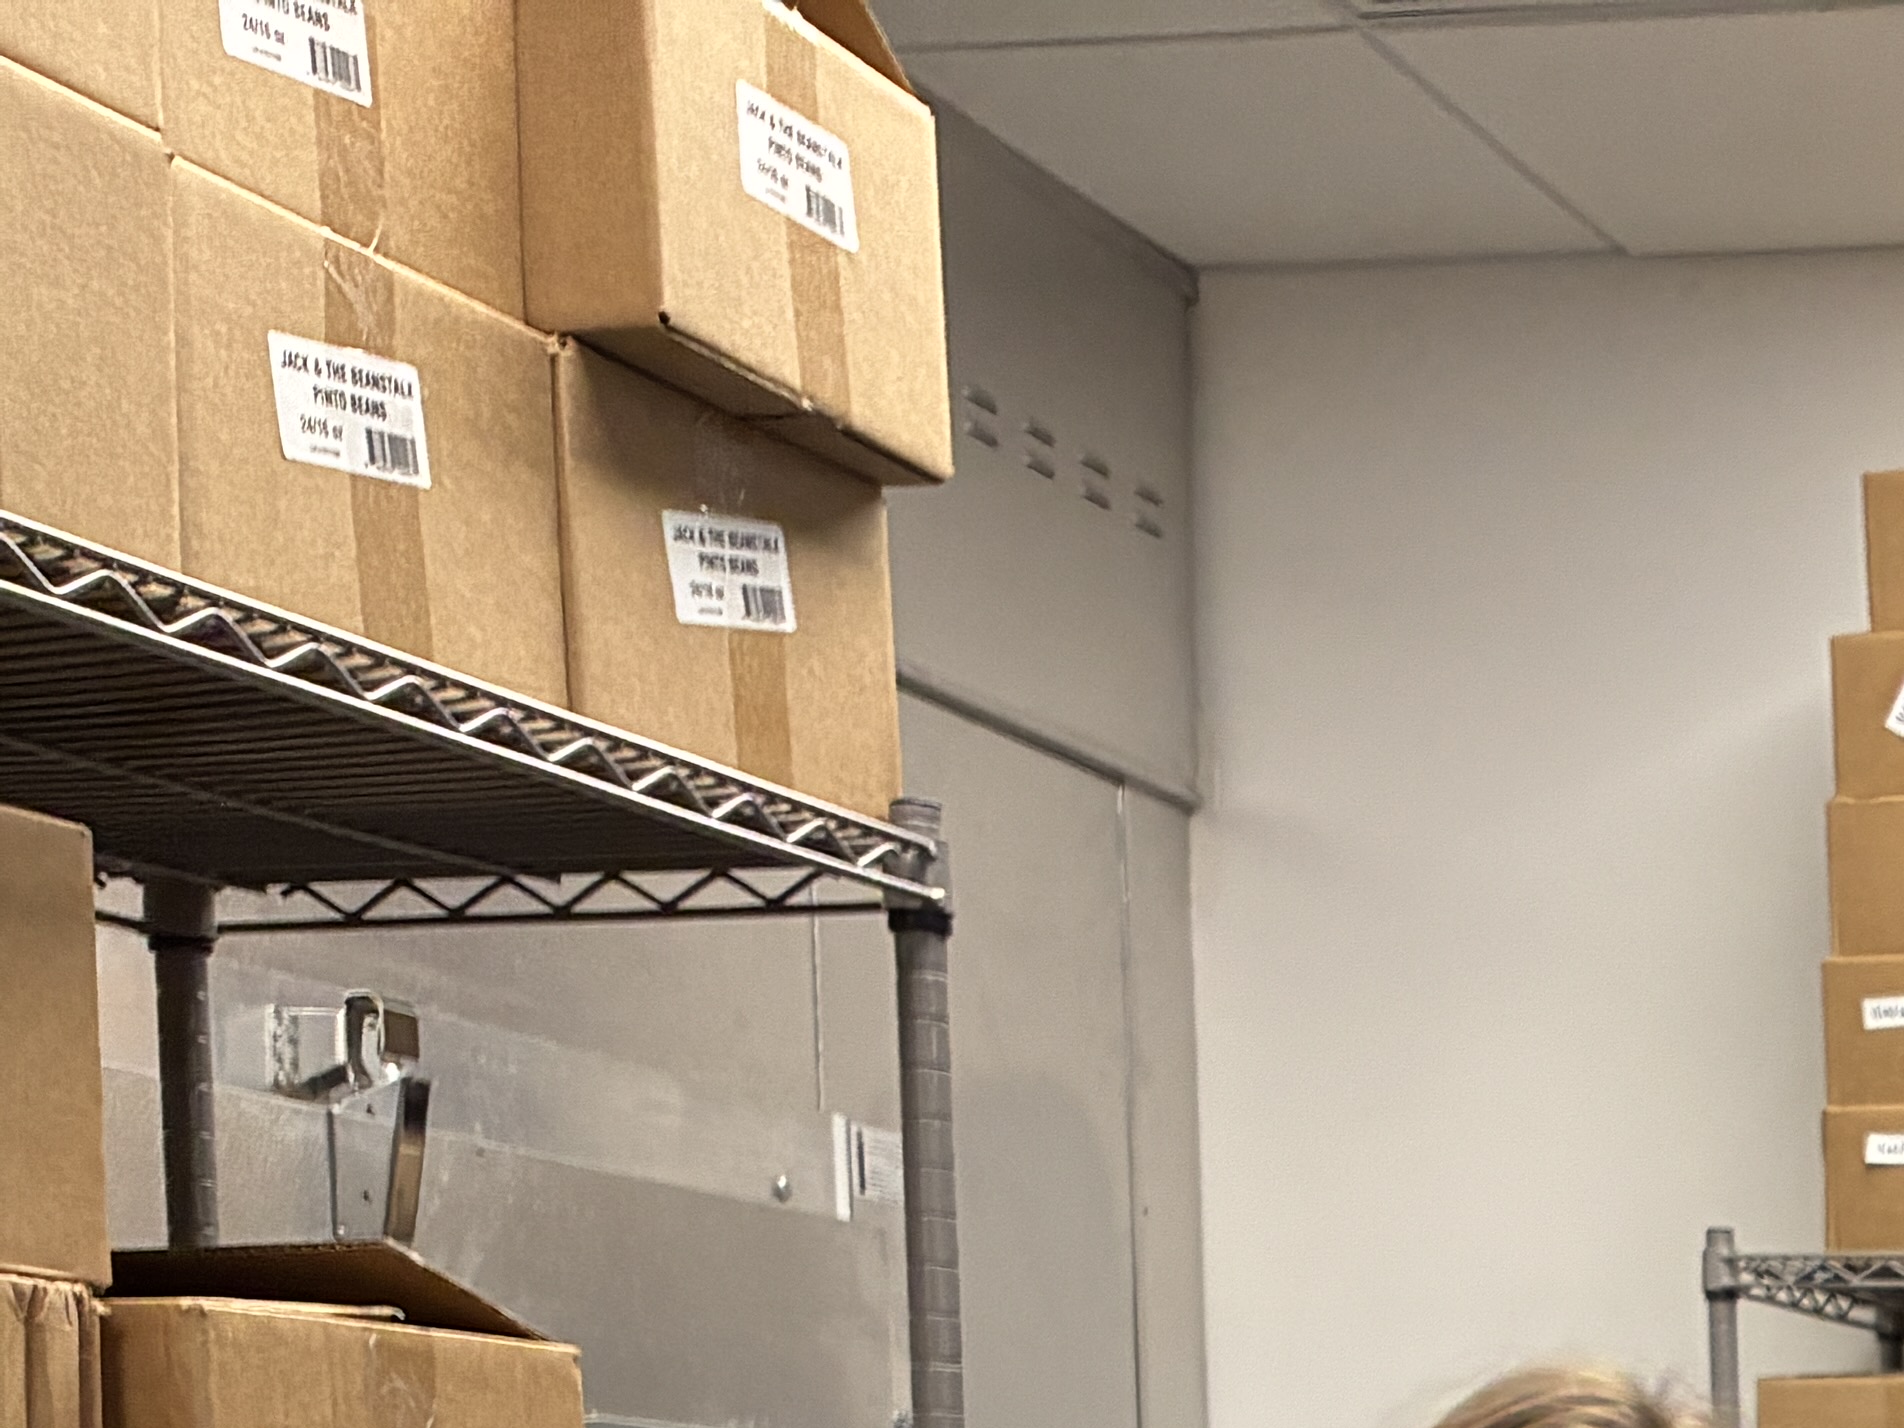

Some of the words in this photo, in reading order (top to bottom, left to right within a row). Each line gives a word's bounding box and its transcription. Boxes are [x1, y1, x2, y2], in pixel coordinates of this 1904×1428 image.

[281, 349, 310, 373] JACK
[314, 357, 323, 378] &
[325, 359, 347, 384] THE
[350, 366, 414, 399] BEANSTALK
[313, 384, 347, 411] PINTO
[350, 393, 388, 423] BEANS
